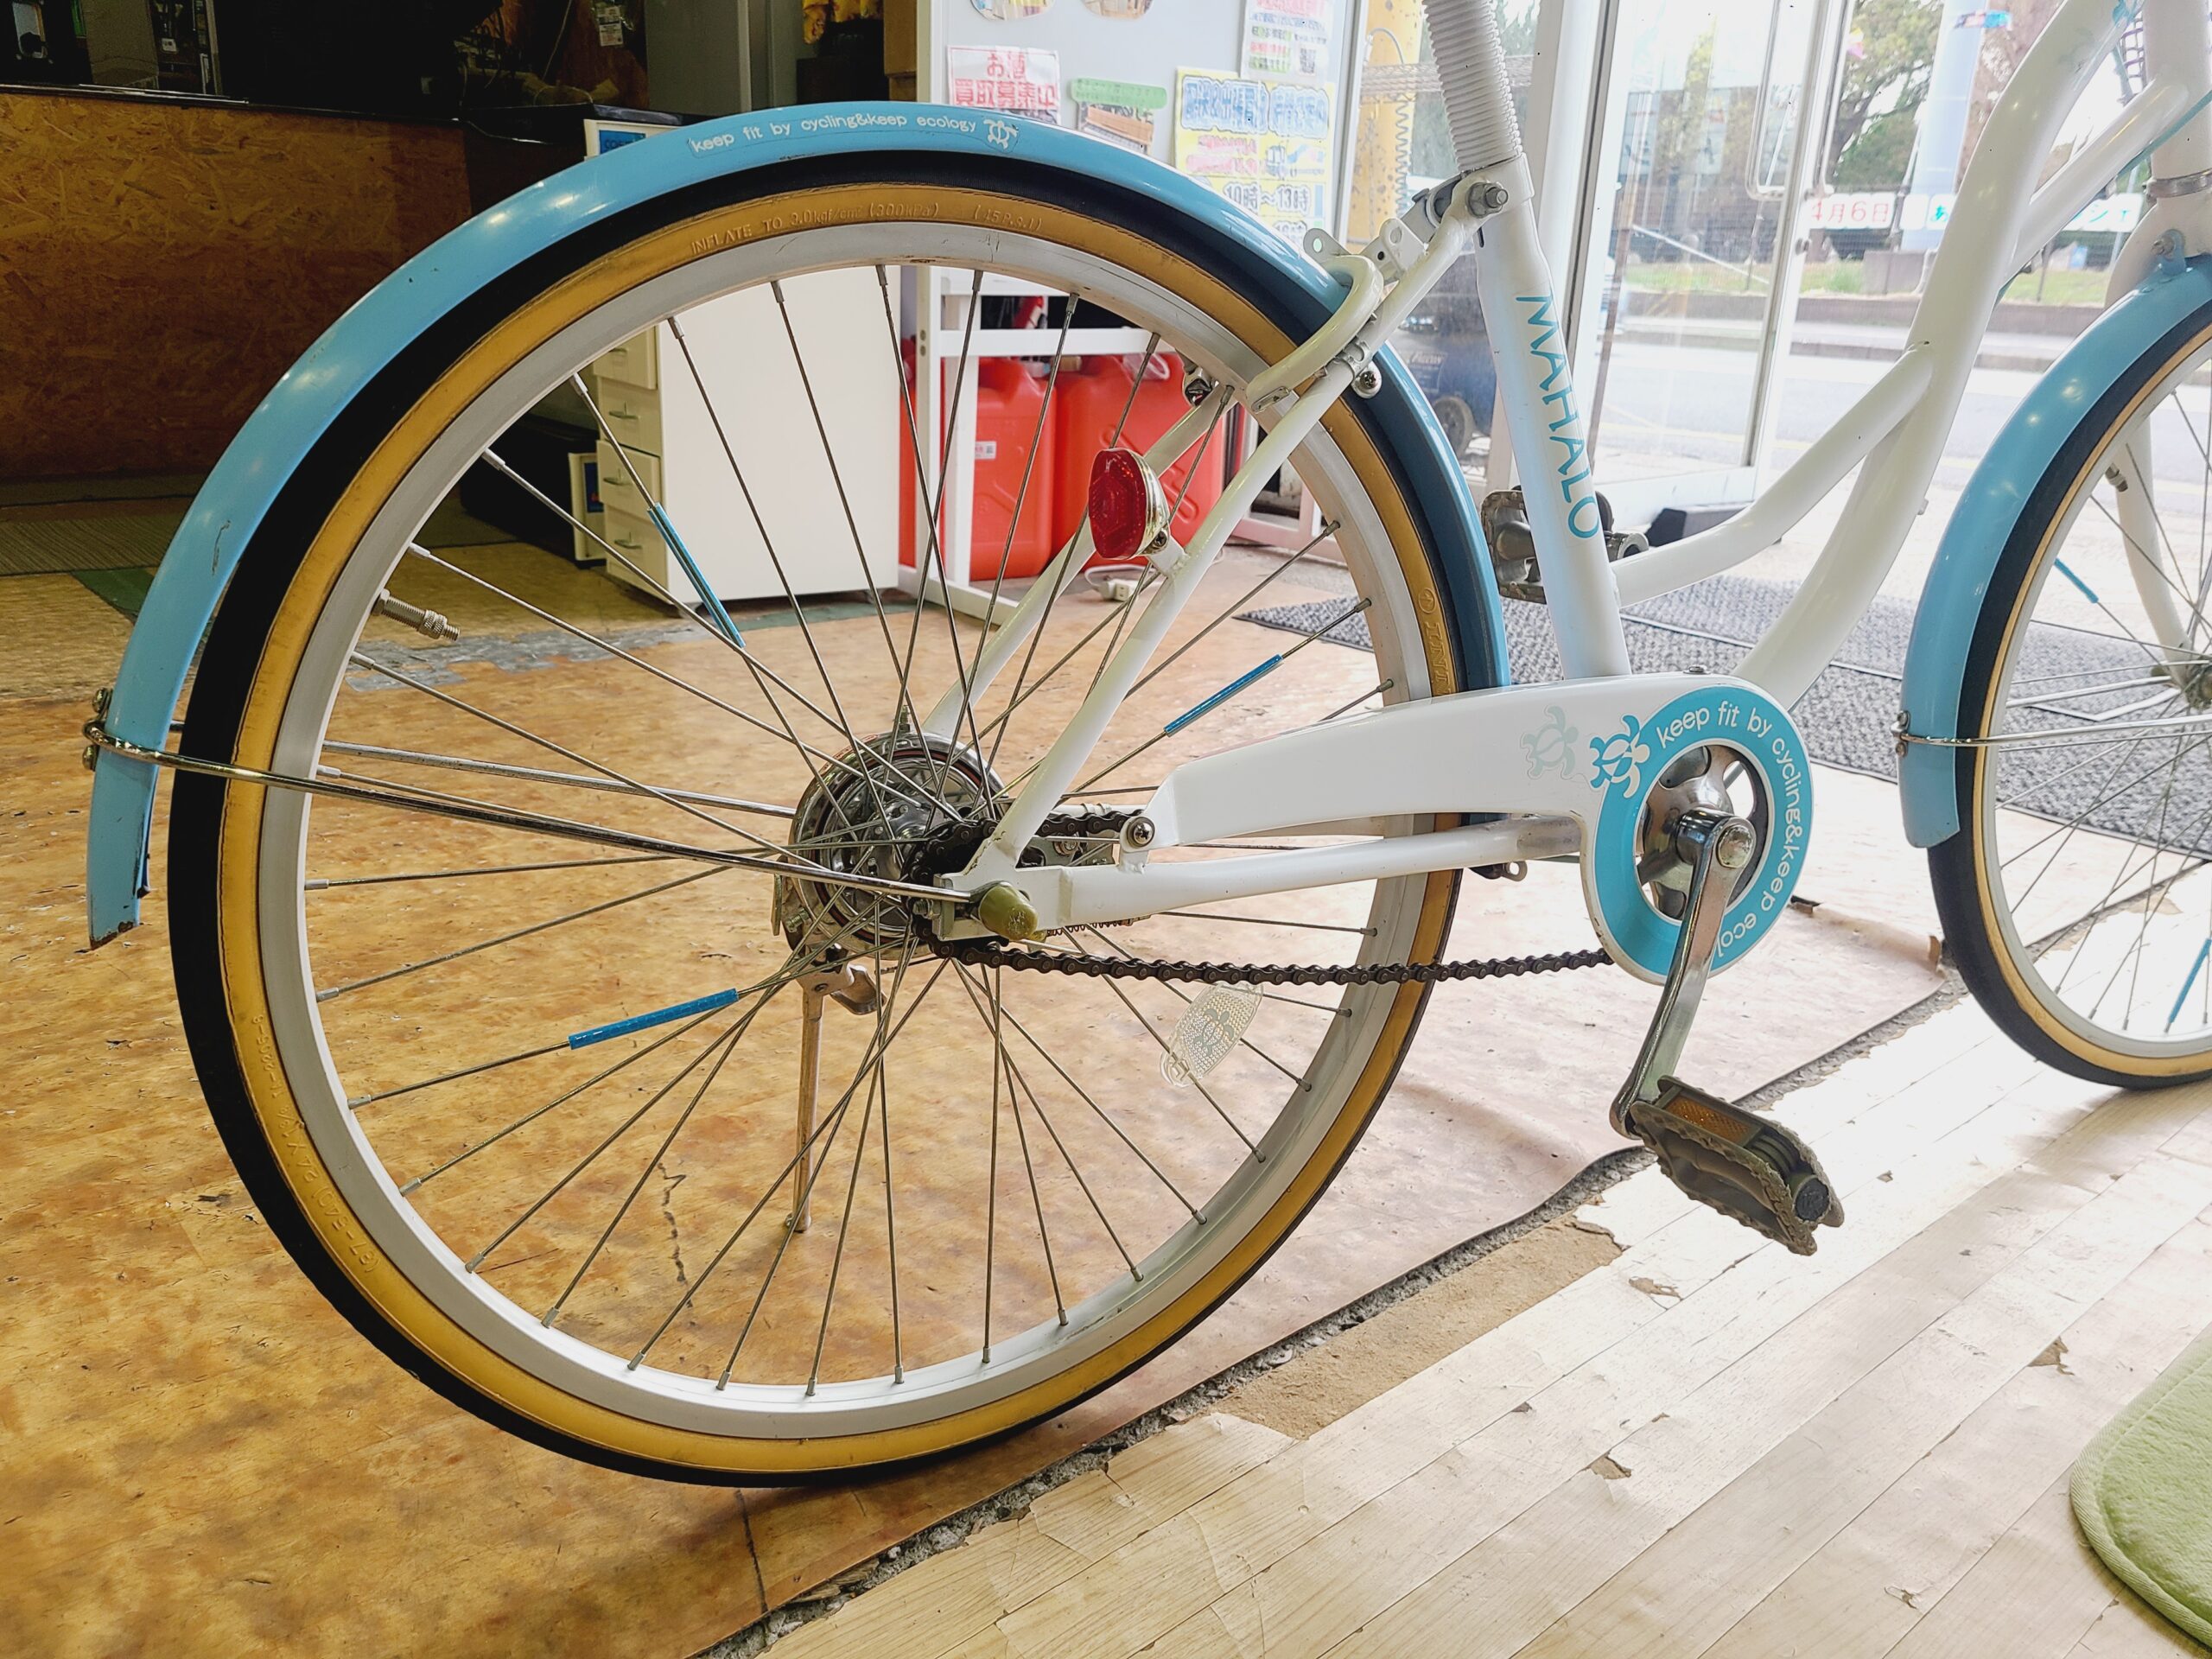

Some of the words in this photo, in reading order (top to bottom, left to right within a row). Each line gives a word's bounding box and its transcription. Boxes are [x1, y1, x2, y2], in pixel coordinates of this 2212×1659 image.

[691, 133, 734, 153] keep
[743, 126, 764, 141] fit
[770, 122, 791, 137] by
[801, 112, 907, 132] cycling&keep
[917, 116, 976, 132] ecology
[1811, 200, 1889, 224] 4月6日
[691, 224, 753, 254] INFLATE
[763, 216, 783, 233] TO
[1515, 294, 1599, 539] MAHALO
[1655, 704, 1711, 749] keep
[1717, 700, 1740, 728] fit
[1747, 707, 1773, 740] by
[1761, 736, 1806, 913] cycling&keep
[1717, 912, 1758, 958] ecol
